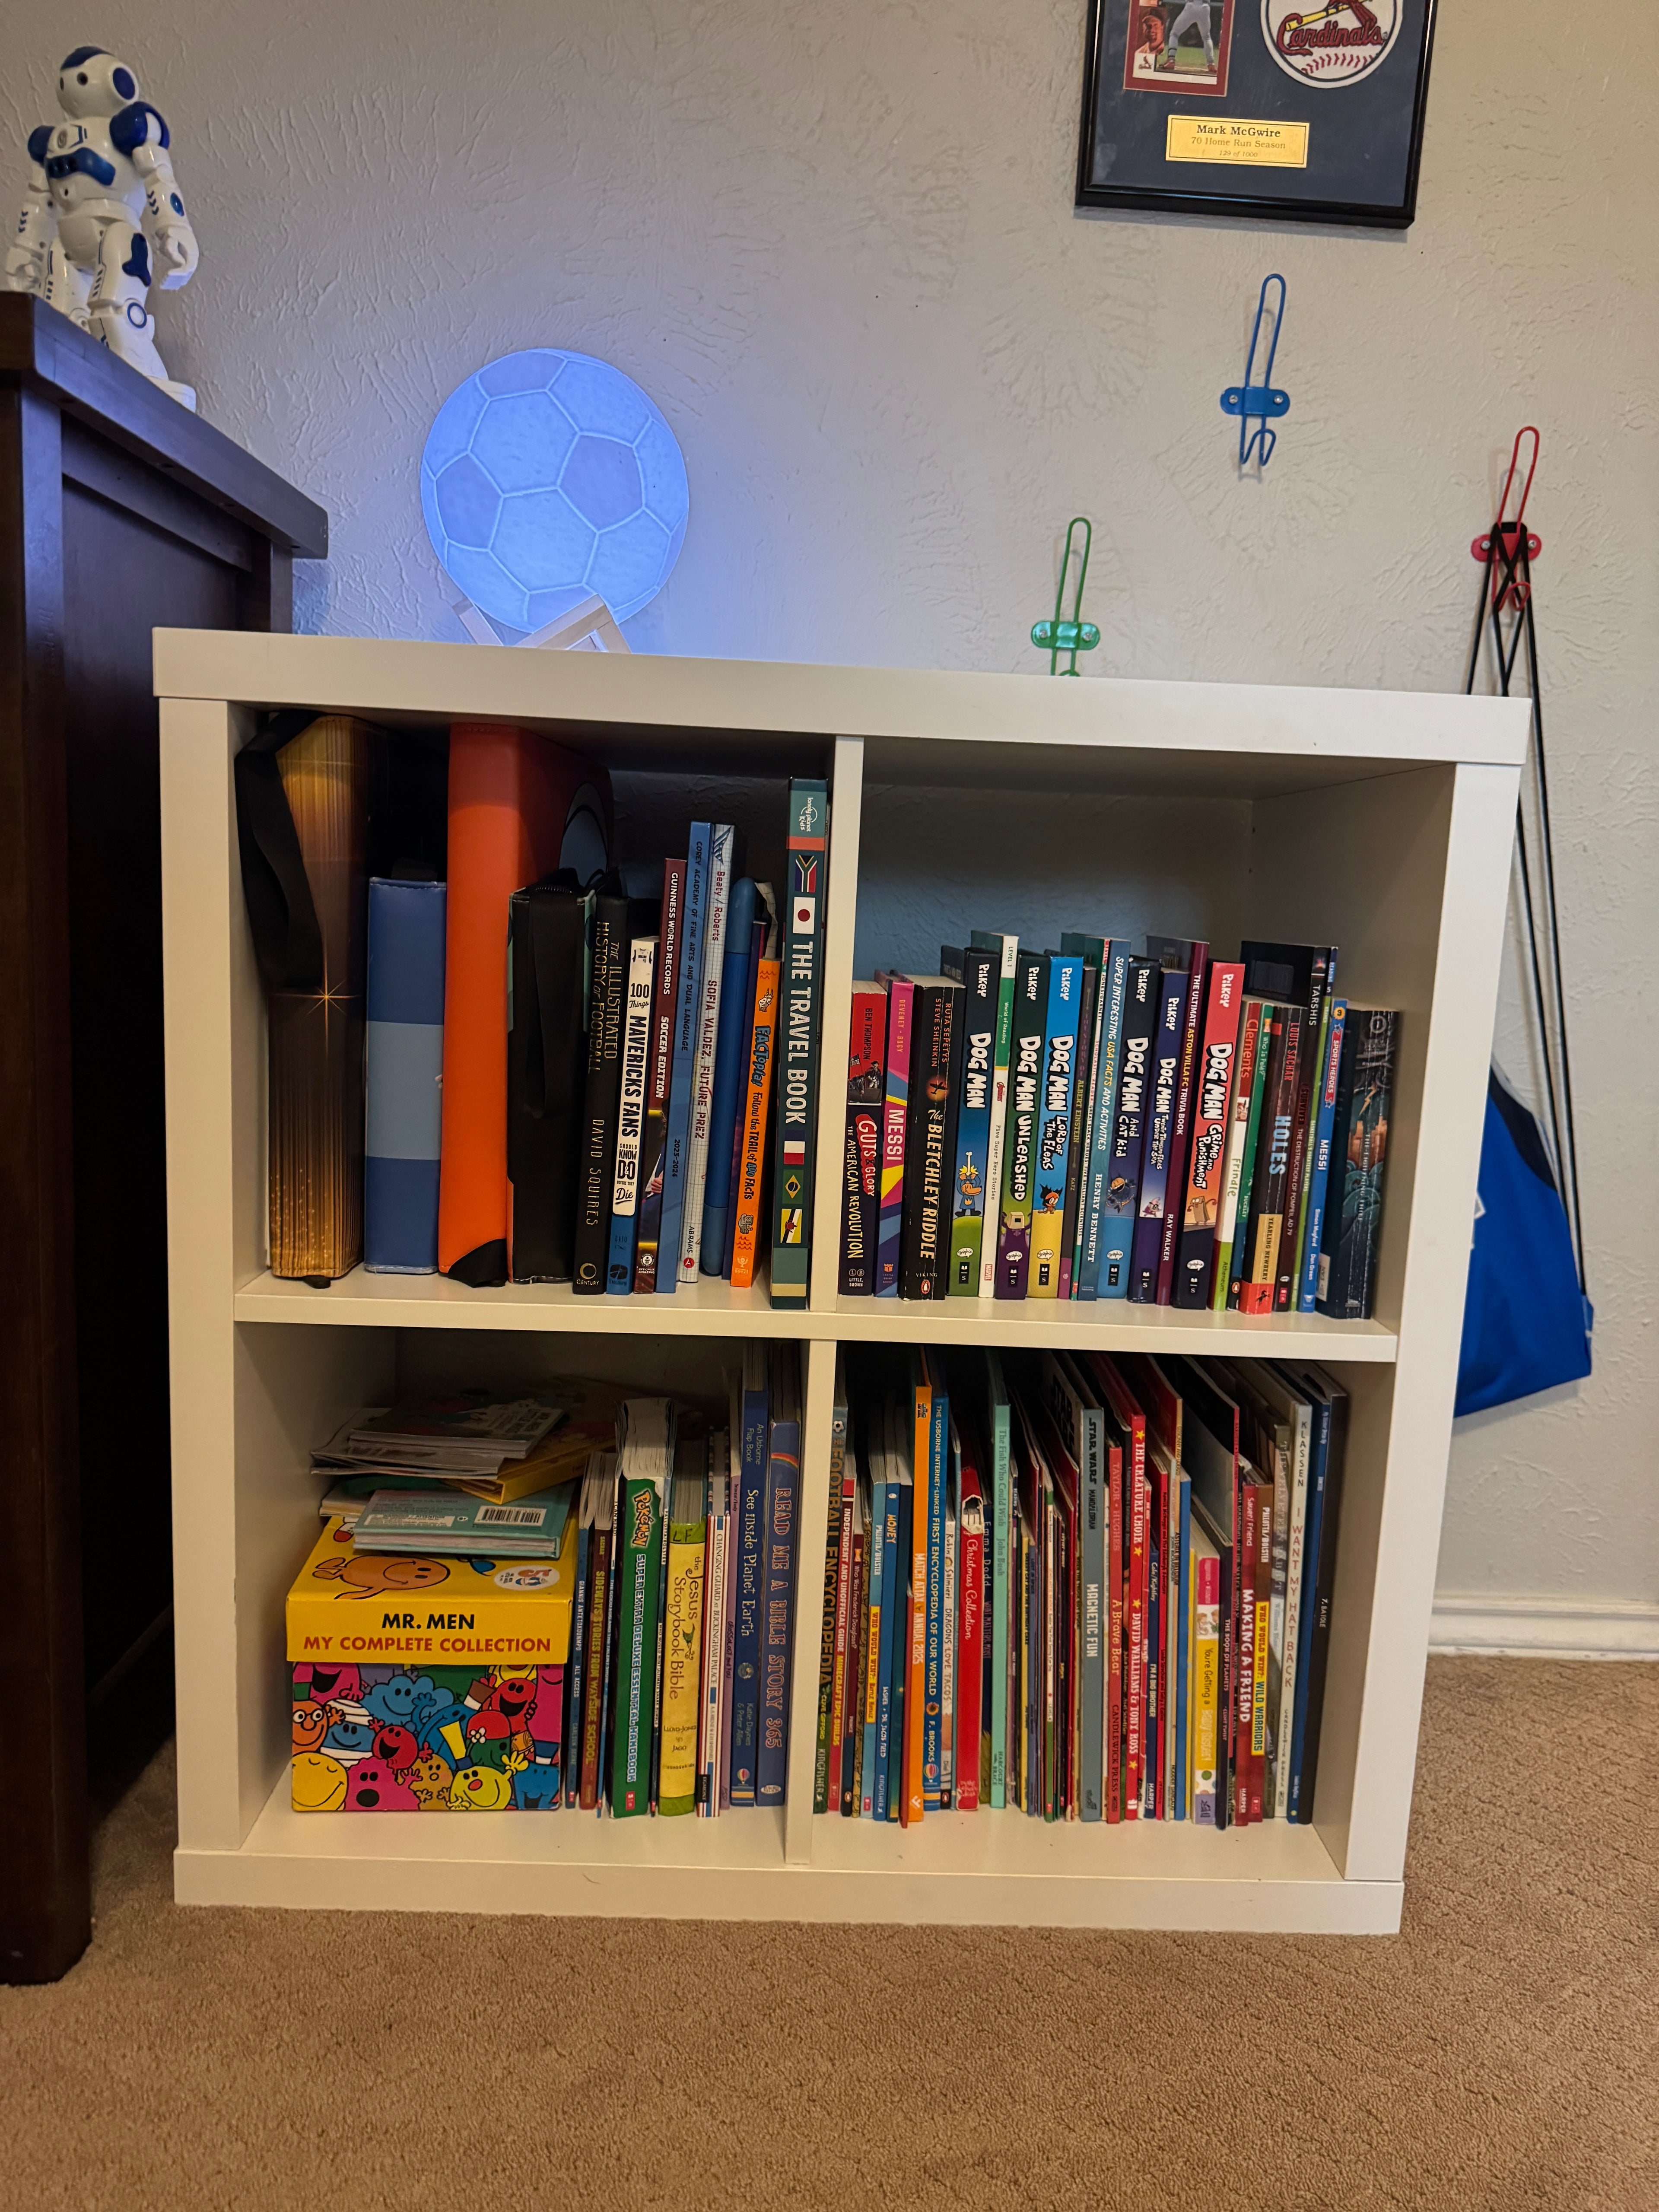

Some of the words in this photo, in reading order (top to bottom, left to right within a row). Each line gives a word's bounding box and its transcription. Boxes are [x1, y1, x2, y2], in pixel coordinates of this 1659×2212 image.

[1277, 13, 1384, 55] Cardinals
[1191, 137, 1202, 146] 70
[1205, 137, 1230, 147] Home
[1234, 139, 1252, 148] Run
[1255, 140, 1286, 150] Season
[1197, 124, 1227, 136] Mark
[1230, 126, 1281, 138] McGwire
[1233, 150, 1240, 159] of
[669, 873, 678, 918] GUINNESS
[715, 871, 725, 896] Beaty
[692, 909, 698, 918] OF
[712, 907, 723, 941] Roberts
[595, 922, 609, 985] HISTORY
[610, 942, 619, 960] THE
[667, 921, 675, 951] WORLD
[663, 953, 672, 994] RECORDS
[791, 941, 813, 979] THE
[1114, 957, 1124, 984] SUPER
[593, 986, 601, 998] OF
[630, 983, 649, 998] 100
[705, 980, 717, 1011] SOFIA
[1193, 974, 1201, 989] THE
[604, 966, 622, 1058] ILLUSTRATED
[1108, 986, 1122, 1039] INTERESTING
[1189, 992, 1199, 1027] ULTIMATE
[1309, 985, 1320, 1025] TARSHIS
[588, 1003, 604, 1074] FOOTBALL
[659, 1016, 669, 1053] SOCCER
[682, 1009, 690, 1051] LANGUAGE
[788, 987, 812, 1062] TRAVEL
[1186, 1028, 1194, 1054] ASTON
[625, 1016, 647, 1096] MAVERICKS
[968, 1033, 992, 1070] DOG
[1183, 1055, 1192, 1076] VILLA
[656, 1055, 667, 1098] EDITION
[698, 1066, 710, 1106] FUTURE
[1104, 1060, 1113, 1085] FACTS
[1182, 1077, 1189, 1087] FC
[751, 1092, 763, 1116] Follow
[785, 1070, 807, 1123] BOOK
[967, 1073, 986, 1108] MAN
[1102, 1087, 1111, 1105] AND
[1179, 1088, 1188, 1112] TRIVIA
[622, 1102, 641, 1137] FANS
[695, 1112, 706, 1139] PREZ
[750, 1119, 760, 1130] the
[928, 1110, 943, 1120] The
[1098, 1107, 1109, 1150] ACTIVITIES
[1176, 1113, 1185, 1135] BOOK
[591, 1120, 604, 1157] DAVID
[748, 1131, 759, 1153] TRAIL
[858, 1120, 877, 1157] GUTS
[887, 1109, 904, 1160] MESSI
[1269, 1116, 1291, 1175] HOLES
[672, 1139, 680, 1177] 2023-2024
[747, 1154, 755, 1162] of
[846, 1140, 859, 1191] AMERICAN
[924, 1124, 942, 1206] BLETCHLEY
[616, 1188, 633, 1200] Die
[864, 1167, 875, 1197] GLORY
[1227, 1158, 1241, 1196] Frindle
[586, 1169, 601, 1225] SQUIRES
[847, 1196, 863, 1258] REVOLUTION
[920, 1208, 937, 1259] RIDDLE
[1265, 1218, 1274, 1249] YEARLING
[1220, 1262, 1228, 1292] Atheneum
[1135, 1443, 1144, 1462] THE
[747, 1490, 758, 1509] See
[1134, 1465, 1144, 1512] CREATURE
[774, 1488, 792, 1535] READ
[745, 1513, 756, 1548] inside
[931, 1518, 940, 1543] FIRST
[1134, 1515, 1143, 1544] CHOIR
[635, 1554, 645, 1589] SUPER
[743, 1554, 756, 1594] Planet
[772, 1545, 790, 1569] ME
[915, 1553, 925, 1579] MATCH
[966, 1539, 978, 1586] Christmas
[593, 1571, 604, 1614] SIDEWAYS
[686, 1568, 703, 1619] Jesus
[771, 1580, 788, 1591] A
[930, 1547, 939, 1619] ENCYCLOPEDIA
[633, 1590, 644, 1624] EXTRA
[667, 1577, 686, 1657] Storybook
[741, 1601, 755, 1636] Earth
[965, 1590, 977, 1639] Collection
[1087, 1584, 1098, 1634] MAGNETIC
[1112, 1600, 1122, 1608] A
[1242, 1589, 1253, 1651] MAKING
[381, 1614, 422, 1629] MR.
[426, 1614, 474, 1630] MEN
[591, 1618, 603, 1652] STORIES
[769, 1600, 787, 1645] BIBLE
[913, 1613, 924, 1642] ANNUAL
[930, 1622, 937, 1634] OF
[1112, 1611, 1121, 1645] Brave
[303, 1637, 332, 1651] MY
[340, 1637, 432, 1651] COMPLETE
[440, 1638, 550, 1652] COLLECTION
[632, 1625, 642, 1666] DELUXE
[912, 1644, 923, 1664] 2025
[1086, 1637, 1097, 1657] FUN
[1112, 1648, 1121, 1675] Bear
[1241, 1657, 1251, 1665] A
[590, 1654, 600, 1677] FROM
[669, 1661, 684, 1699] Bible
[766, 1655, 785, 1710] STORY
[588, 1679, 598, 1722] WAYSIDE
[629, 1668, 641, 1725] ESSENTIAL
[1239, 1671, 1251, 1722] FRIEND
[585, 1725, 596, 1764] SCHOOL
[765, 1718, 782, 1748] 365
[627, 1726, 638, 1782] HANDBOOK
